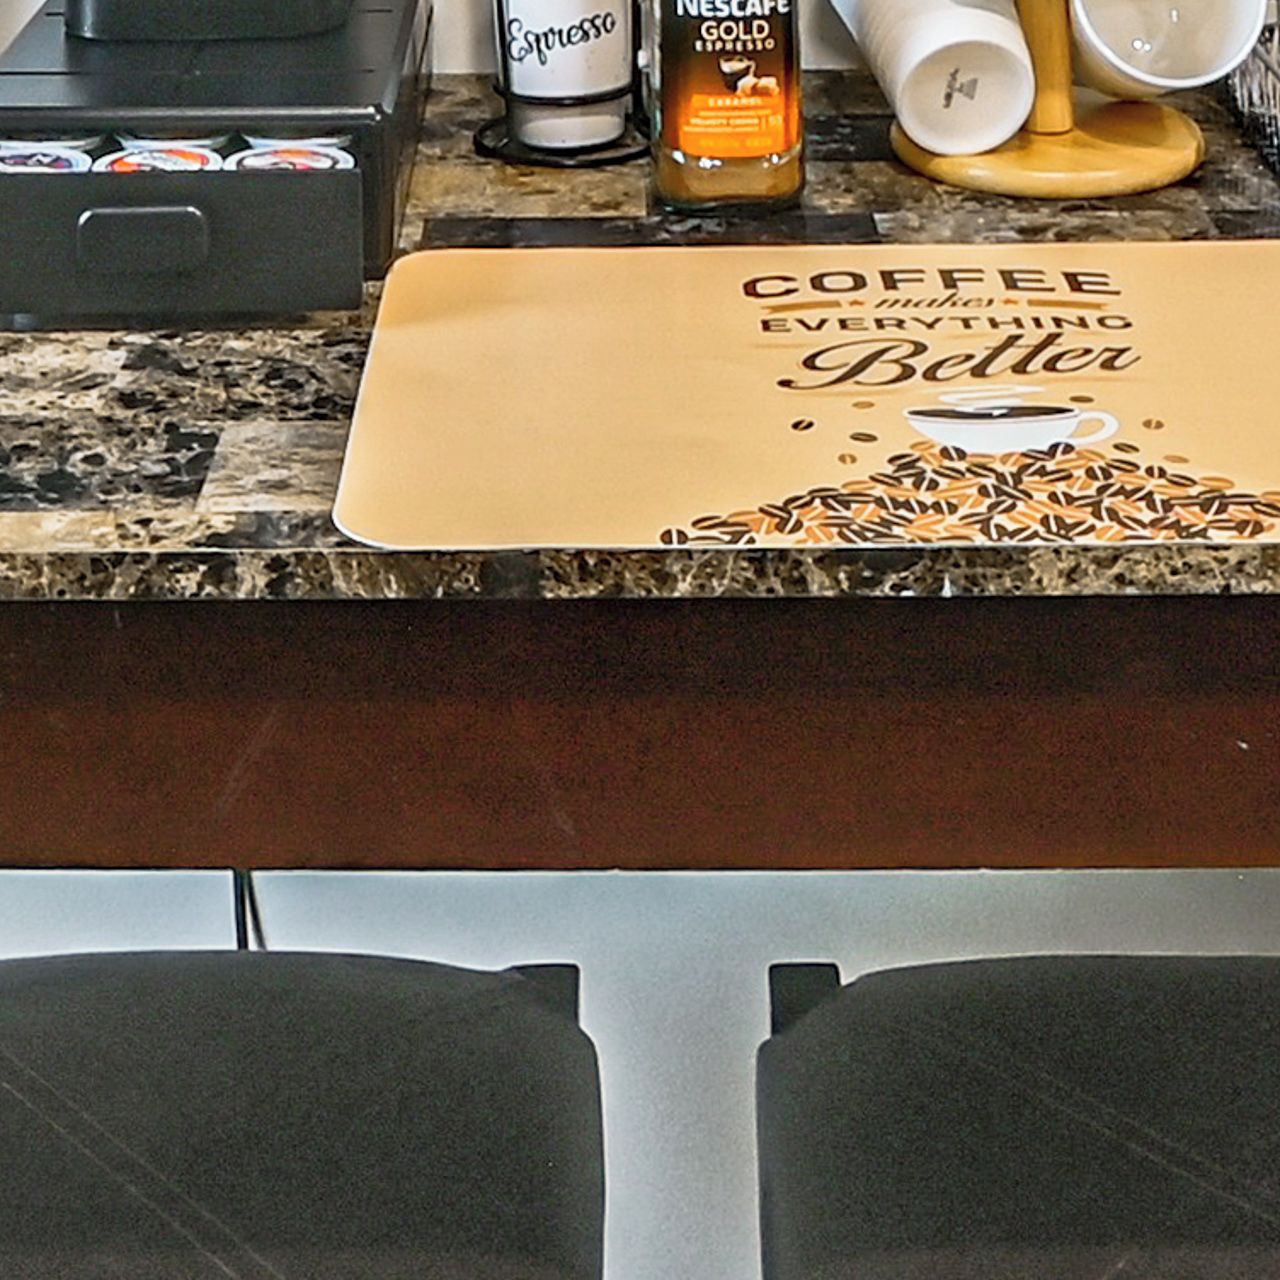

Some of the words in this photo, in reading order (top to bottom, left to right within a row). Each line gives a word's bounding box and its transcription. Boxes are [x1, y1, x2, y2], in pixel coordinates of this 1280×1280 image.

[507, 11, 616, 66] Espresso
[700, 19, 771, 40] GOLD
[694, 40, 776, 52] ESPRESSO
[741, 268, 1122, 299] COFFEE
[873, 287, 997, 309] makes
[759, 314, 1134, 333] EVERYTHING
[775, 331, 1142, 391] Better
